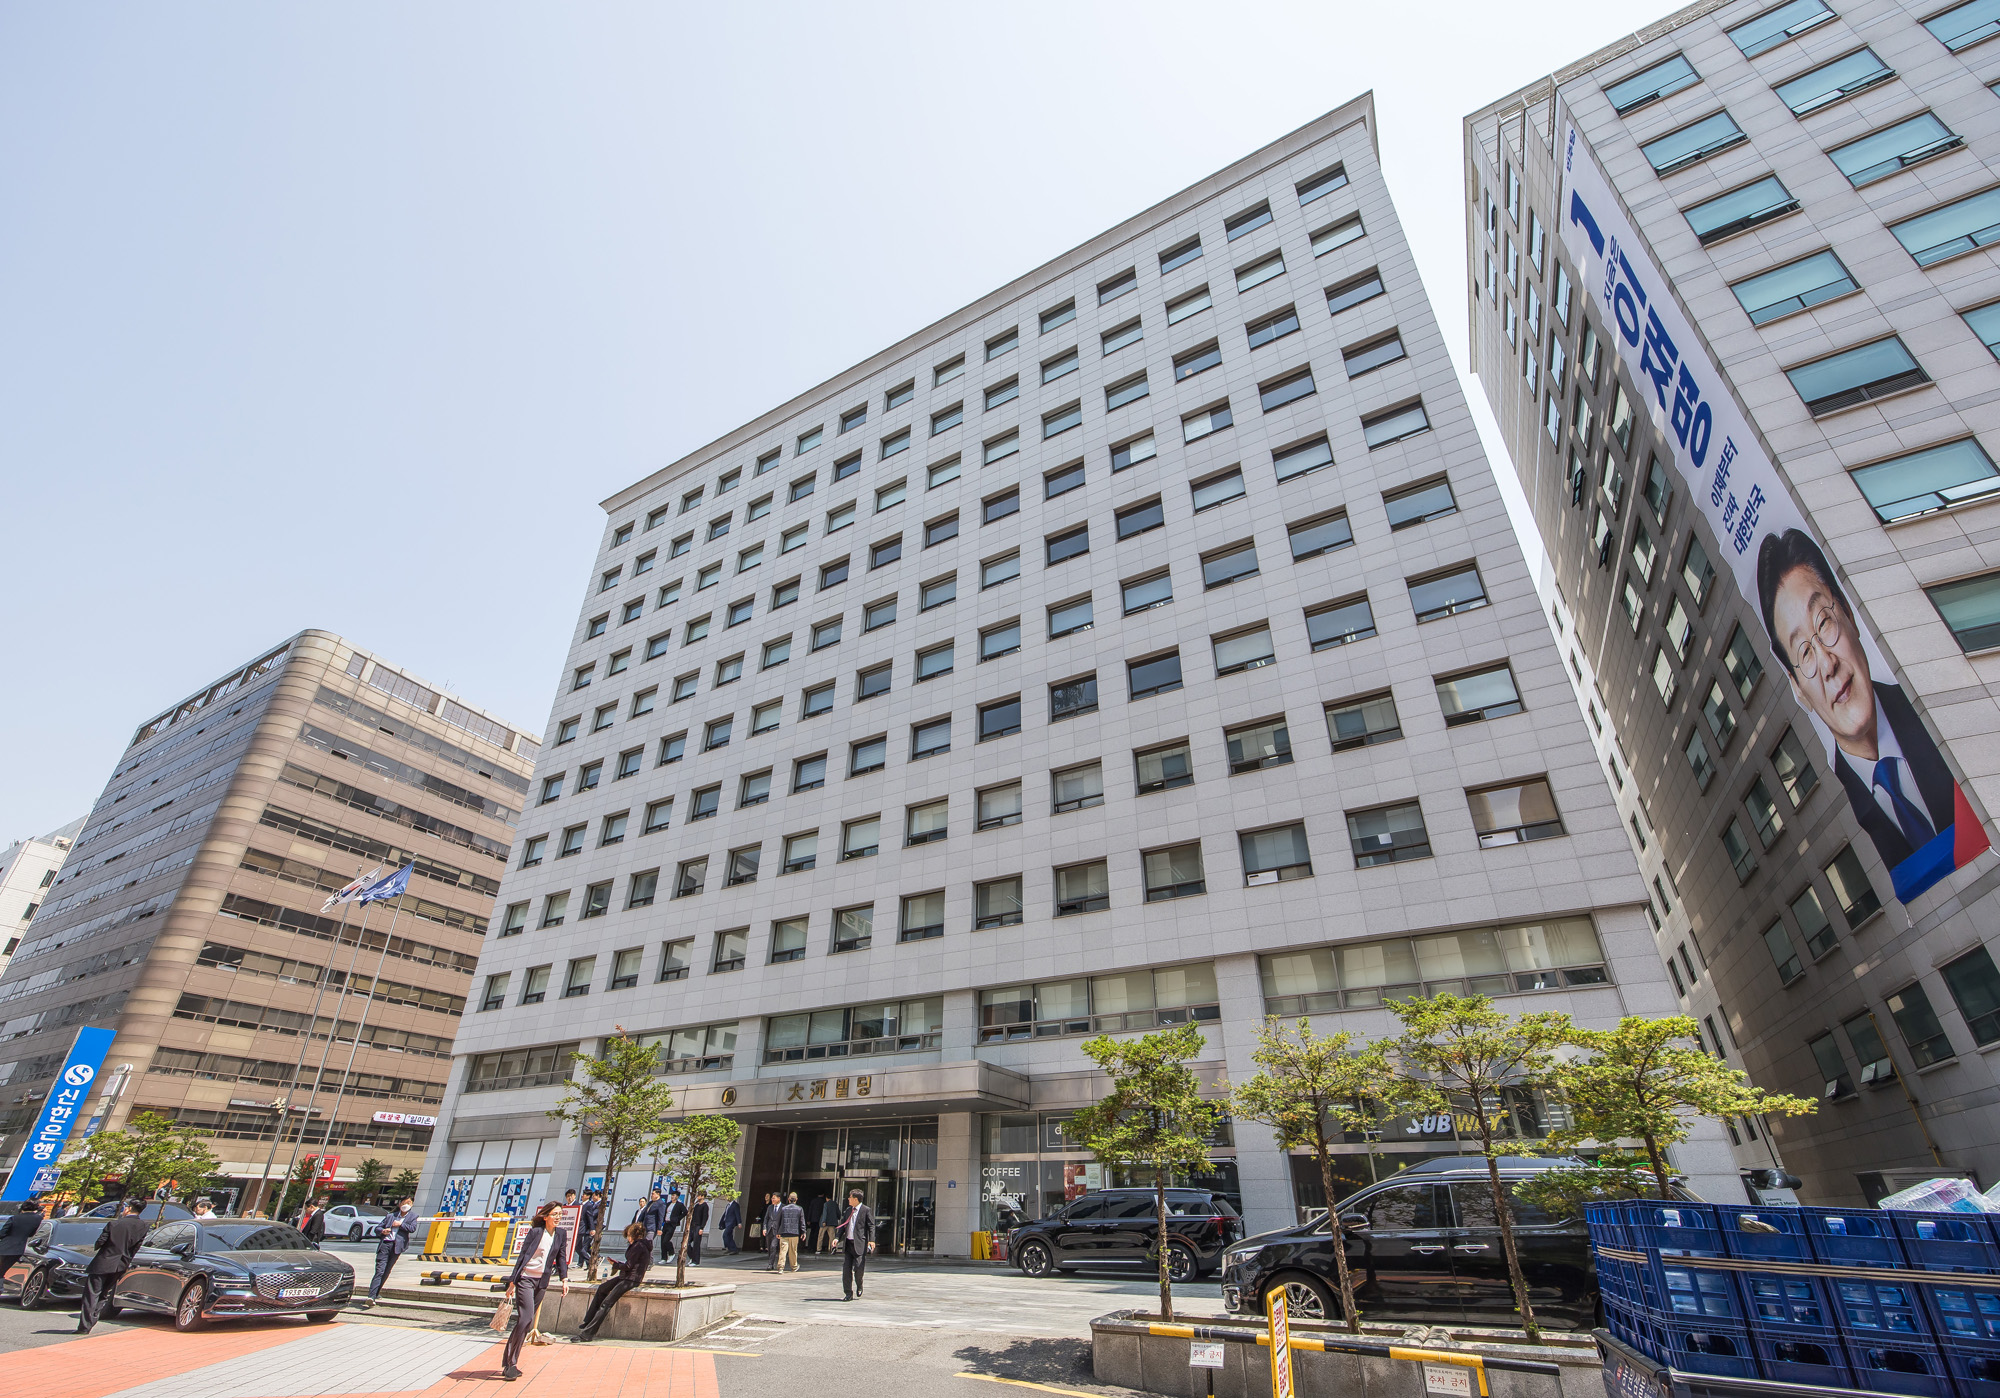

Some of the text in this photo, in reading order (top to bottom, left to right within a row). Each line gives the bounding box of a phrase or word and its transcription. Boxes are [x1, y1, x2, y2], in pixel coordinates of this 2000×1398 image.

[1571, 188, 1605, 259] 1
[1603, 235, 1620, 309] 지금은
[1613, 249, 1712, 468] 이재명
[1701, 435, 1738, 508] 이제부터
[1722, 491, 1740, 534] 진짜
[1733, 483, 1766, 555] 대한민국
[787, 1075, 872, 1101] 大河빌딩
[33, 1088, 80, 1161] 신한은행
[982, 1167, 1020, 1177] COFFEE
[983, 1180, 1006, 1190] AND
[982, 1192, 1026, 1202] DESSERT
[1193, 1349, 1222, 1359] 주차 금지
[1429, 1375, 1467, 1388] 주차 금지
